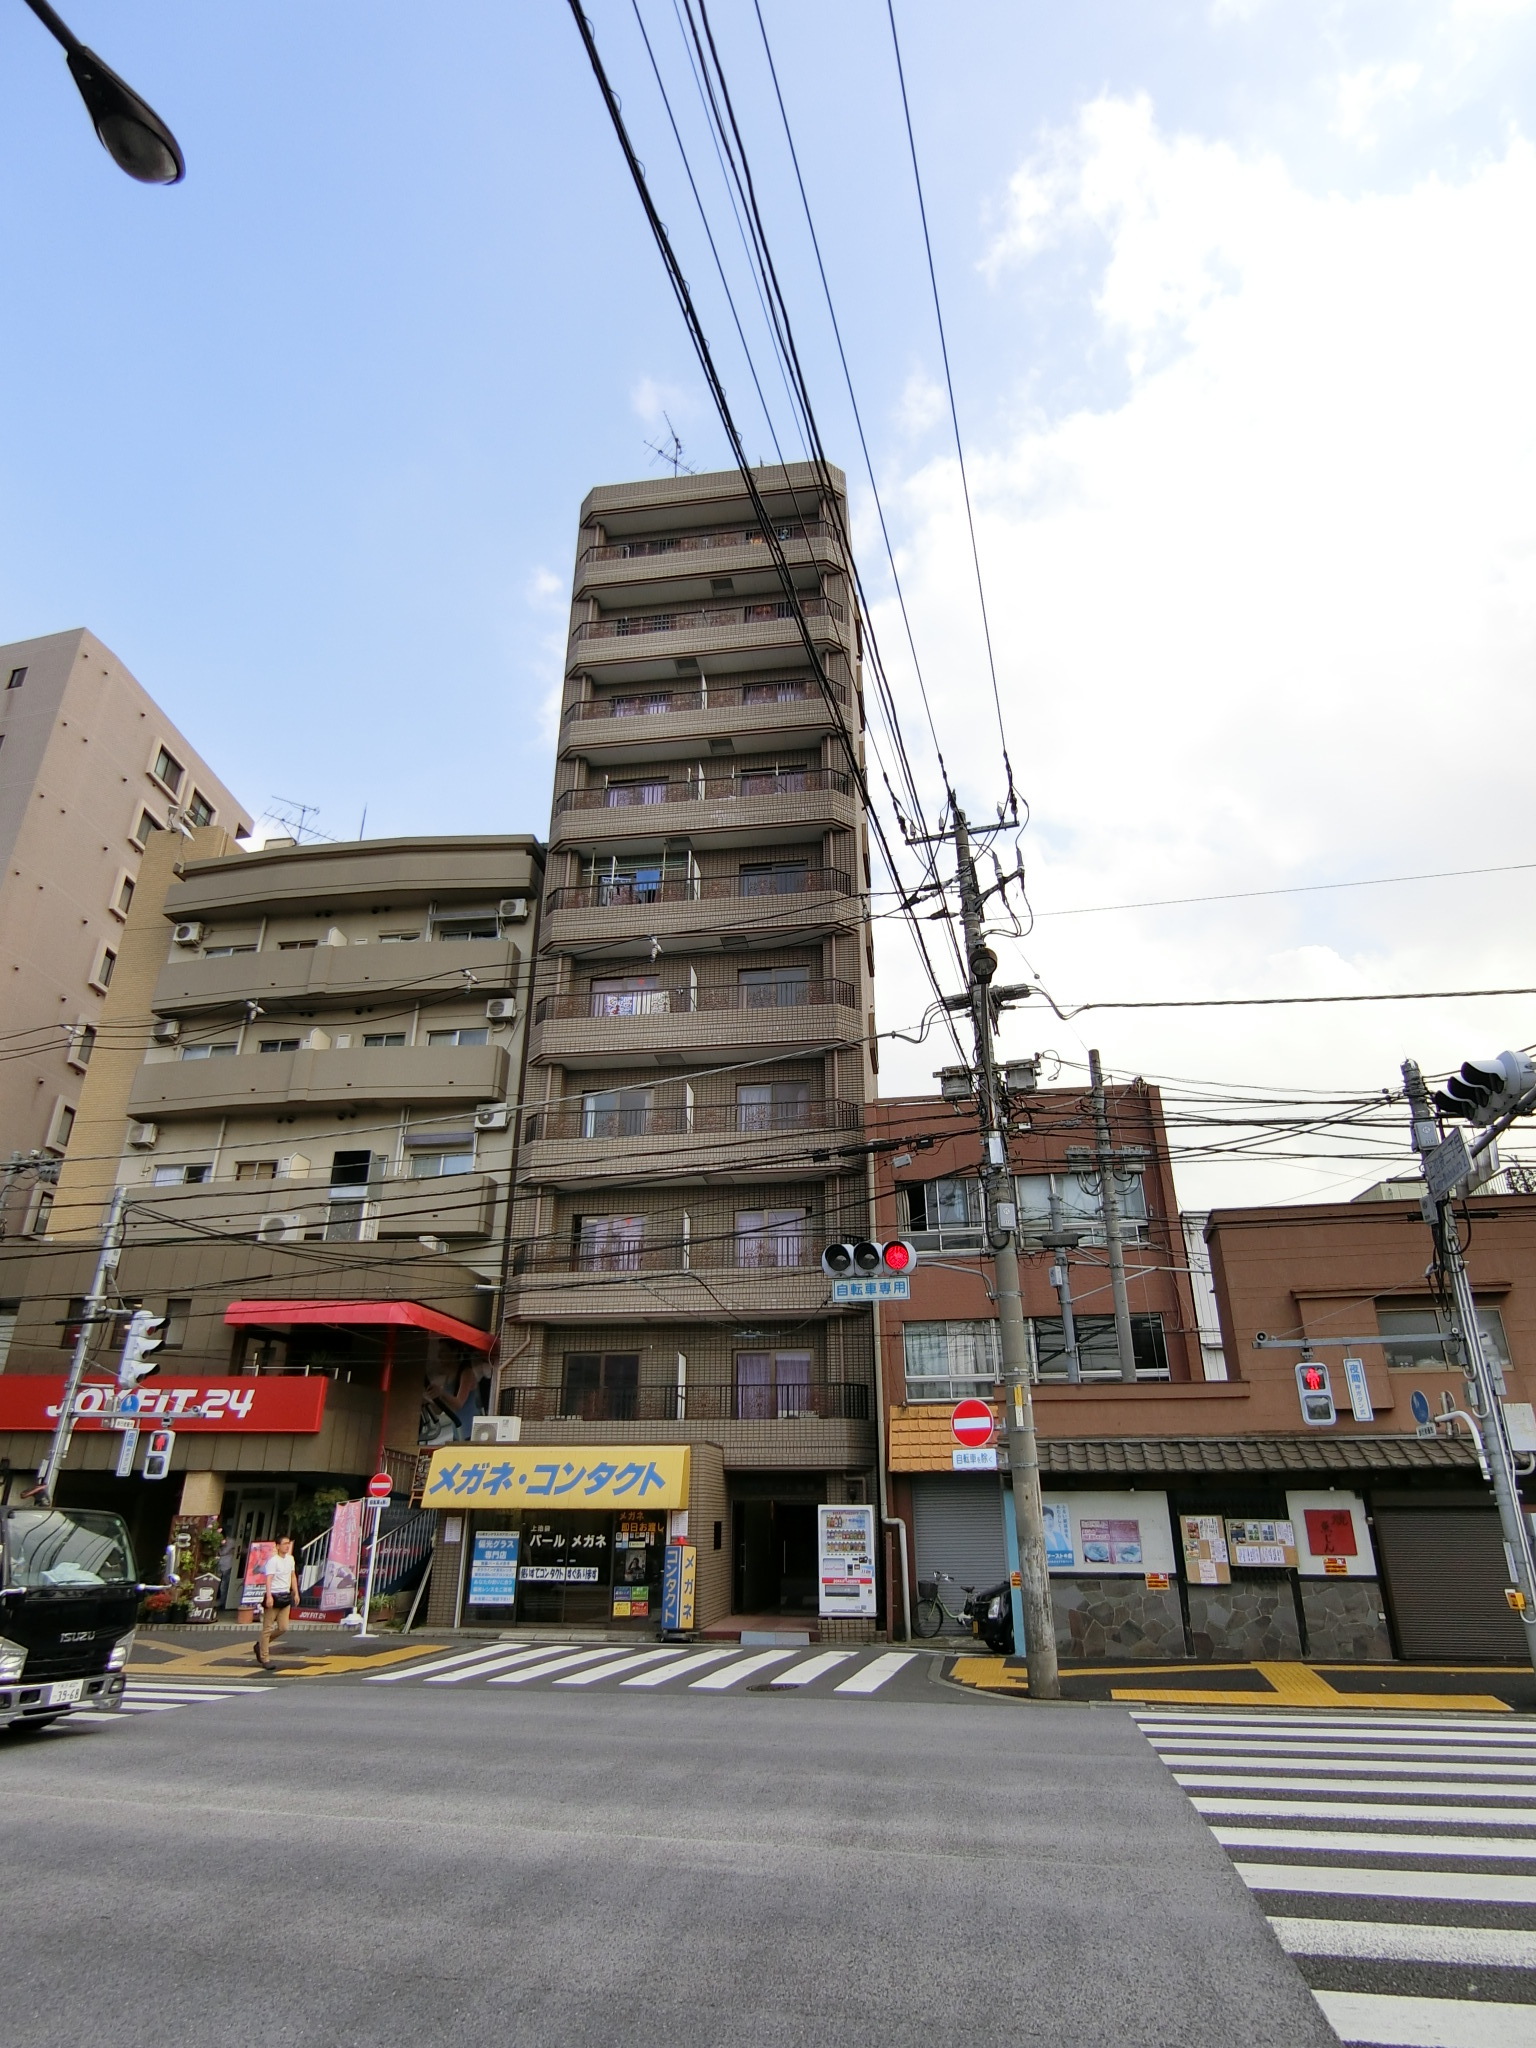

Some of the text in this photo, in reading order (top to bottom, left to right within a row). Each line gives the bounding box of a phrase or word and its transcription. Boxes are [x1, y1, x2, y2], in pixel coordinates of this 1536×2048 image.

[837, 1281, 905, 1296] 自転車専用
[200, 1389, 256, 1418] 24
[956, 1453, 993, 1465] 自転車を除く
[429, 1461, 666, 1496] メガネ・コンタクト
[619, 1512, 644, 1520] メガネ
[621, 1522, 665, 1532] 即日お渡し
[478, 1540, 514, 1549] 偏光グラス
[571, 1534, 607, 1549] メガネ
[485, 1551, 508, 1560] 専門店
[664, 1550, 679, 1623] コンタクト
[682, 1555, 695, 1620] メガネ
[59, 1631, 97, 1644] ISUZU
[56, 1688, 81, 1702] 39-68
